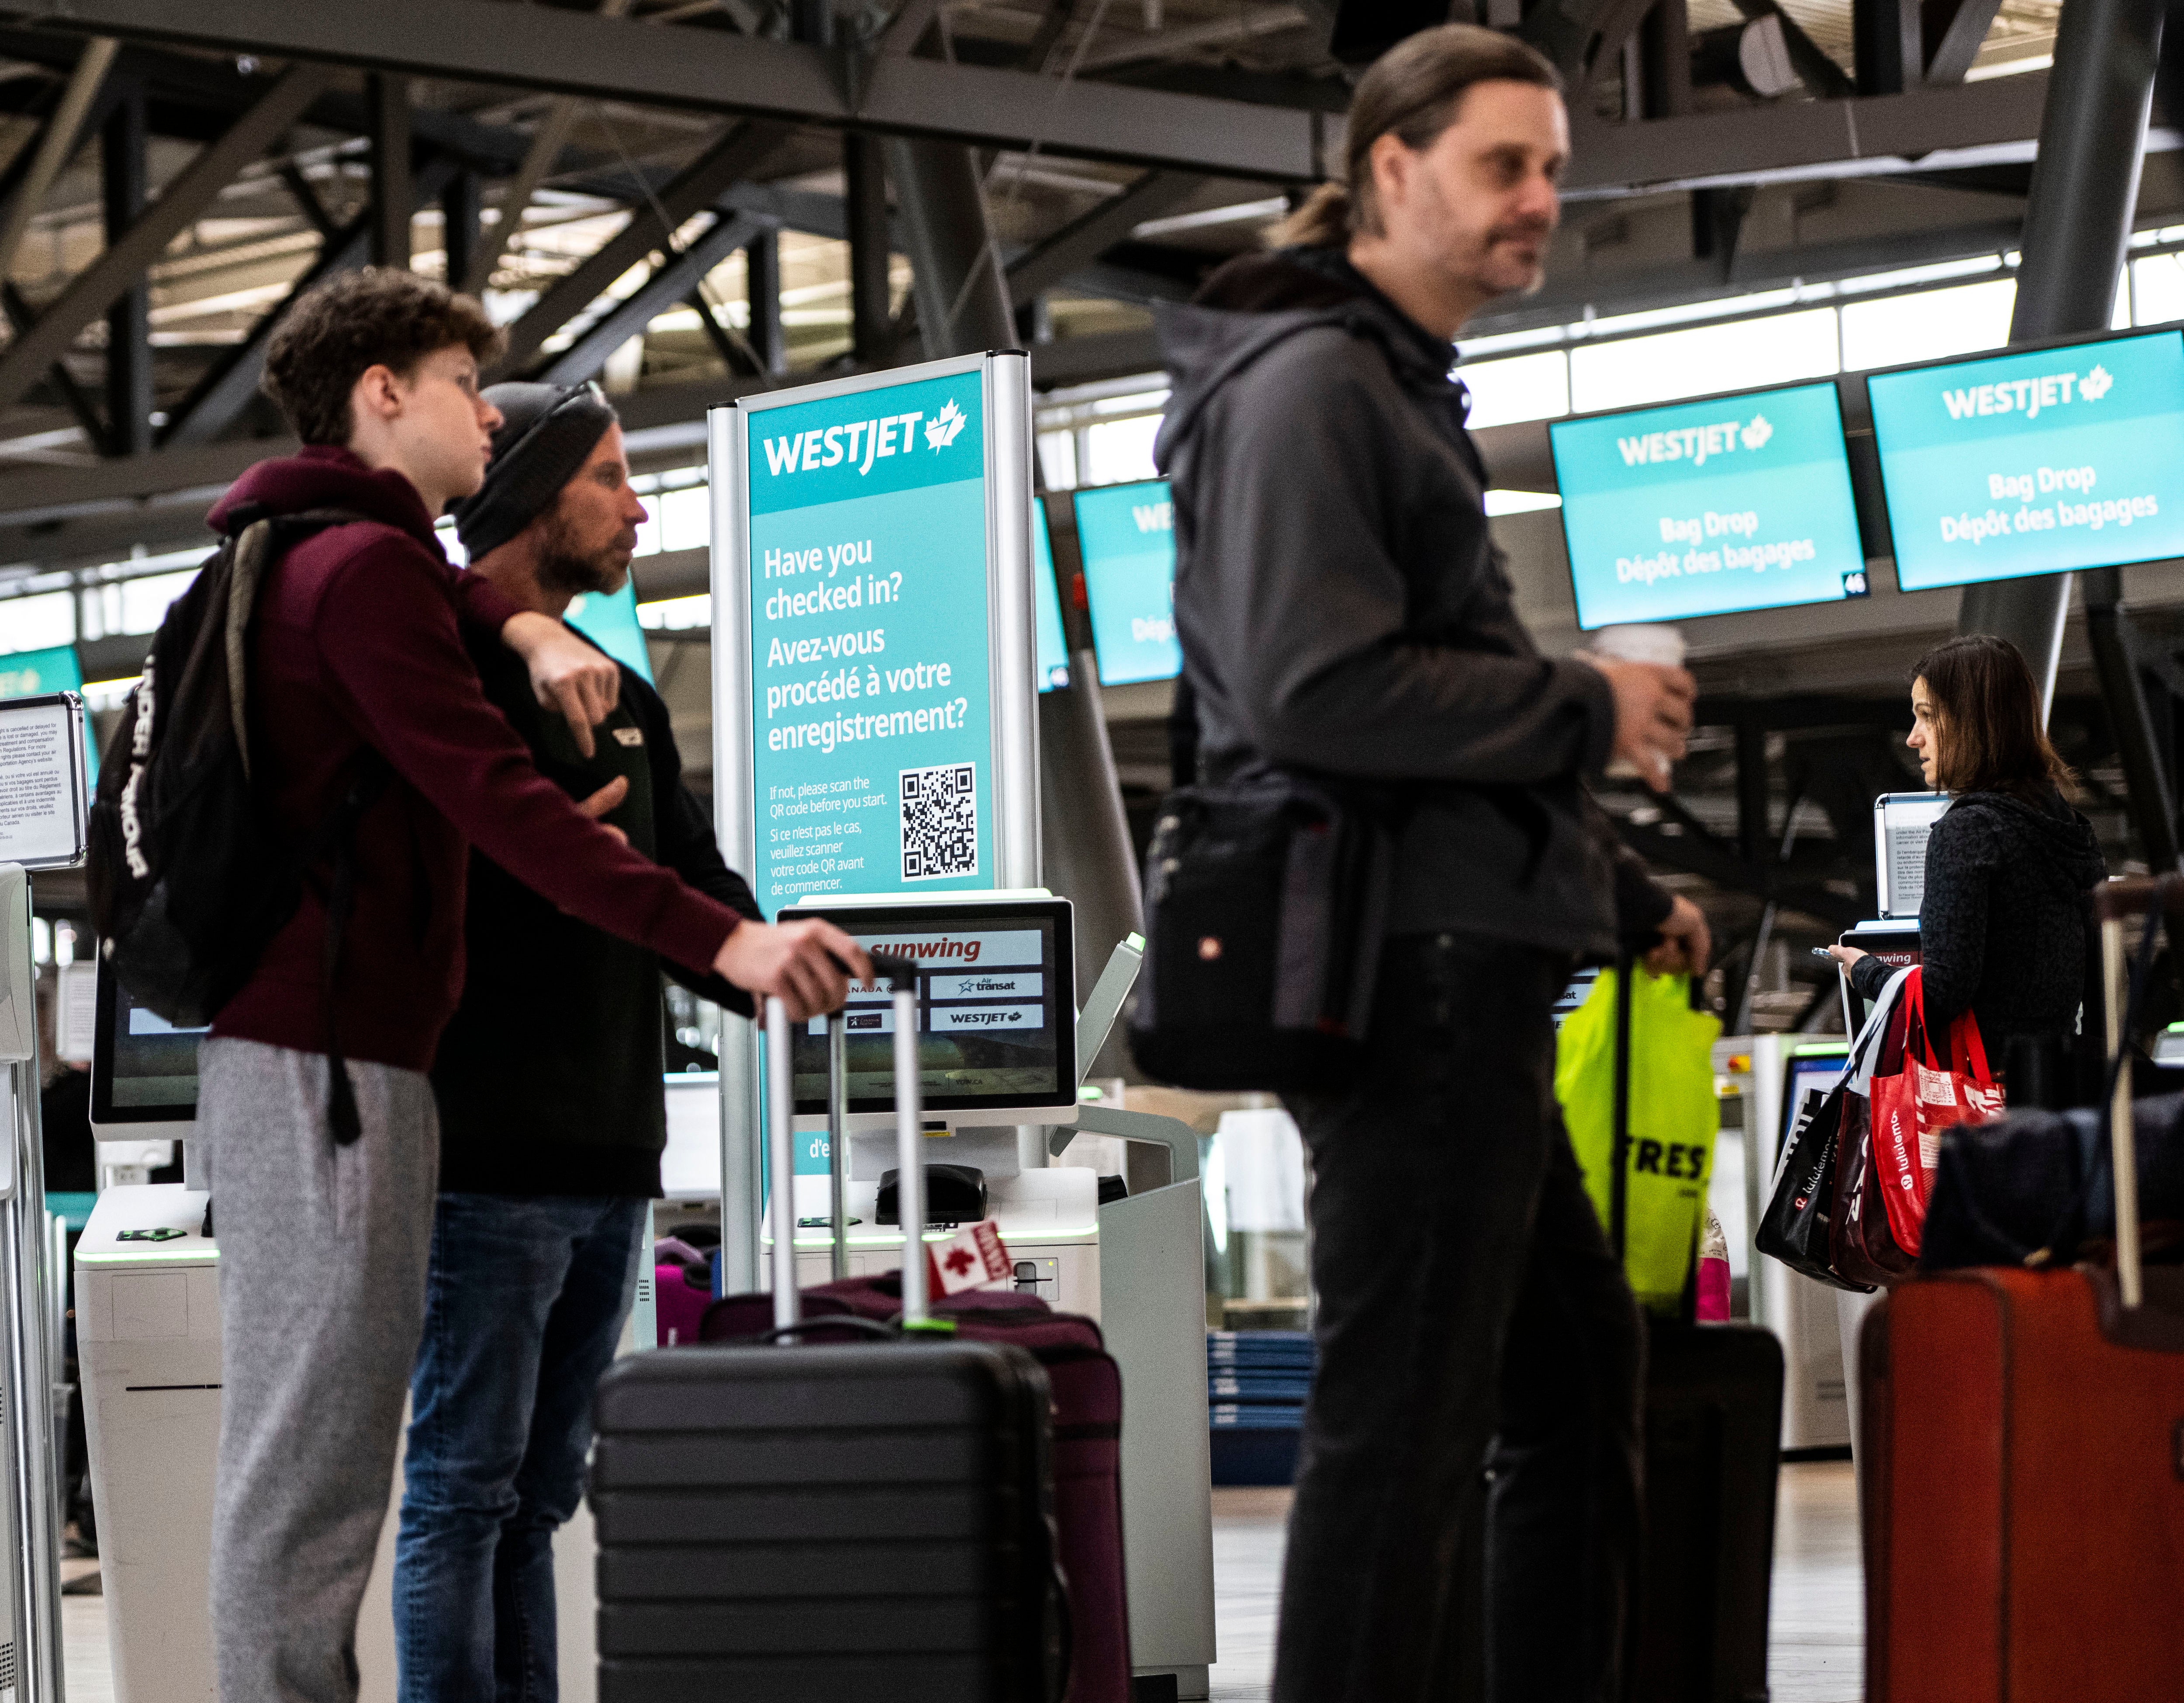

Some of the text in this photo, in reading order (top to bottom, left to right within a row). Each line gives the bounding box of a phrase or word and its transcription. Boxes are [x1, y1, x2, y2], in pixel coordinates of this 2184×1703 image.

[1942, 373, 2077, 419] WESTJET
[763, 411, 923, 476] WESTJET
[1617, 422, 1739, 466] WESTJET
[1988, 465, 2096, 502] Bag Drop
[1132, 502, 1172, 533] WE
[1659, 512, 1759, 545] Bag Drop
[1940, 495, 2158, 545] Dépôt des bagages
[765, 540, 872, 578] Have you
[1616, 538, 1815, 586] Dépôt des bagages
[766, 571, 903, 620] checked in?
[767, 629, 885, 668] Avez-vous
[767, 662, 951, 718] procédé à votre
[768, 698, 968, 754] enregistrement?
[770, 776, 869, 800] If not, please scan the
[770, 793, 887, 820] QR code before you start.
[771, 821, 862, 842] Si ce n'est pas le cas,
[771, 842, 843, 859] veuillez scanner
[771, 857, 864, 877] votre code QR avant
[771, 879, 843, 895] de commencer.
[871, 937, 981, 962] sunwing
[1876, 953, 1911, 964] nwing
[976, 981, 1015, 991] transat
[950, 1013, 1007, 1025] WESTJET
